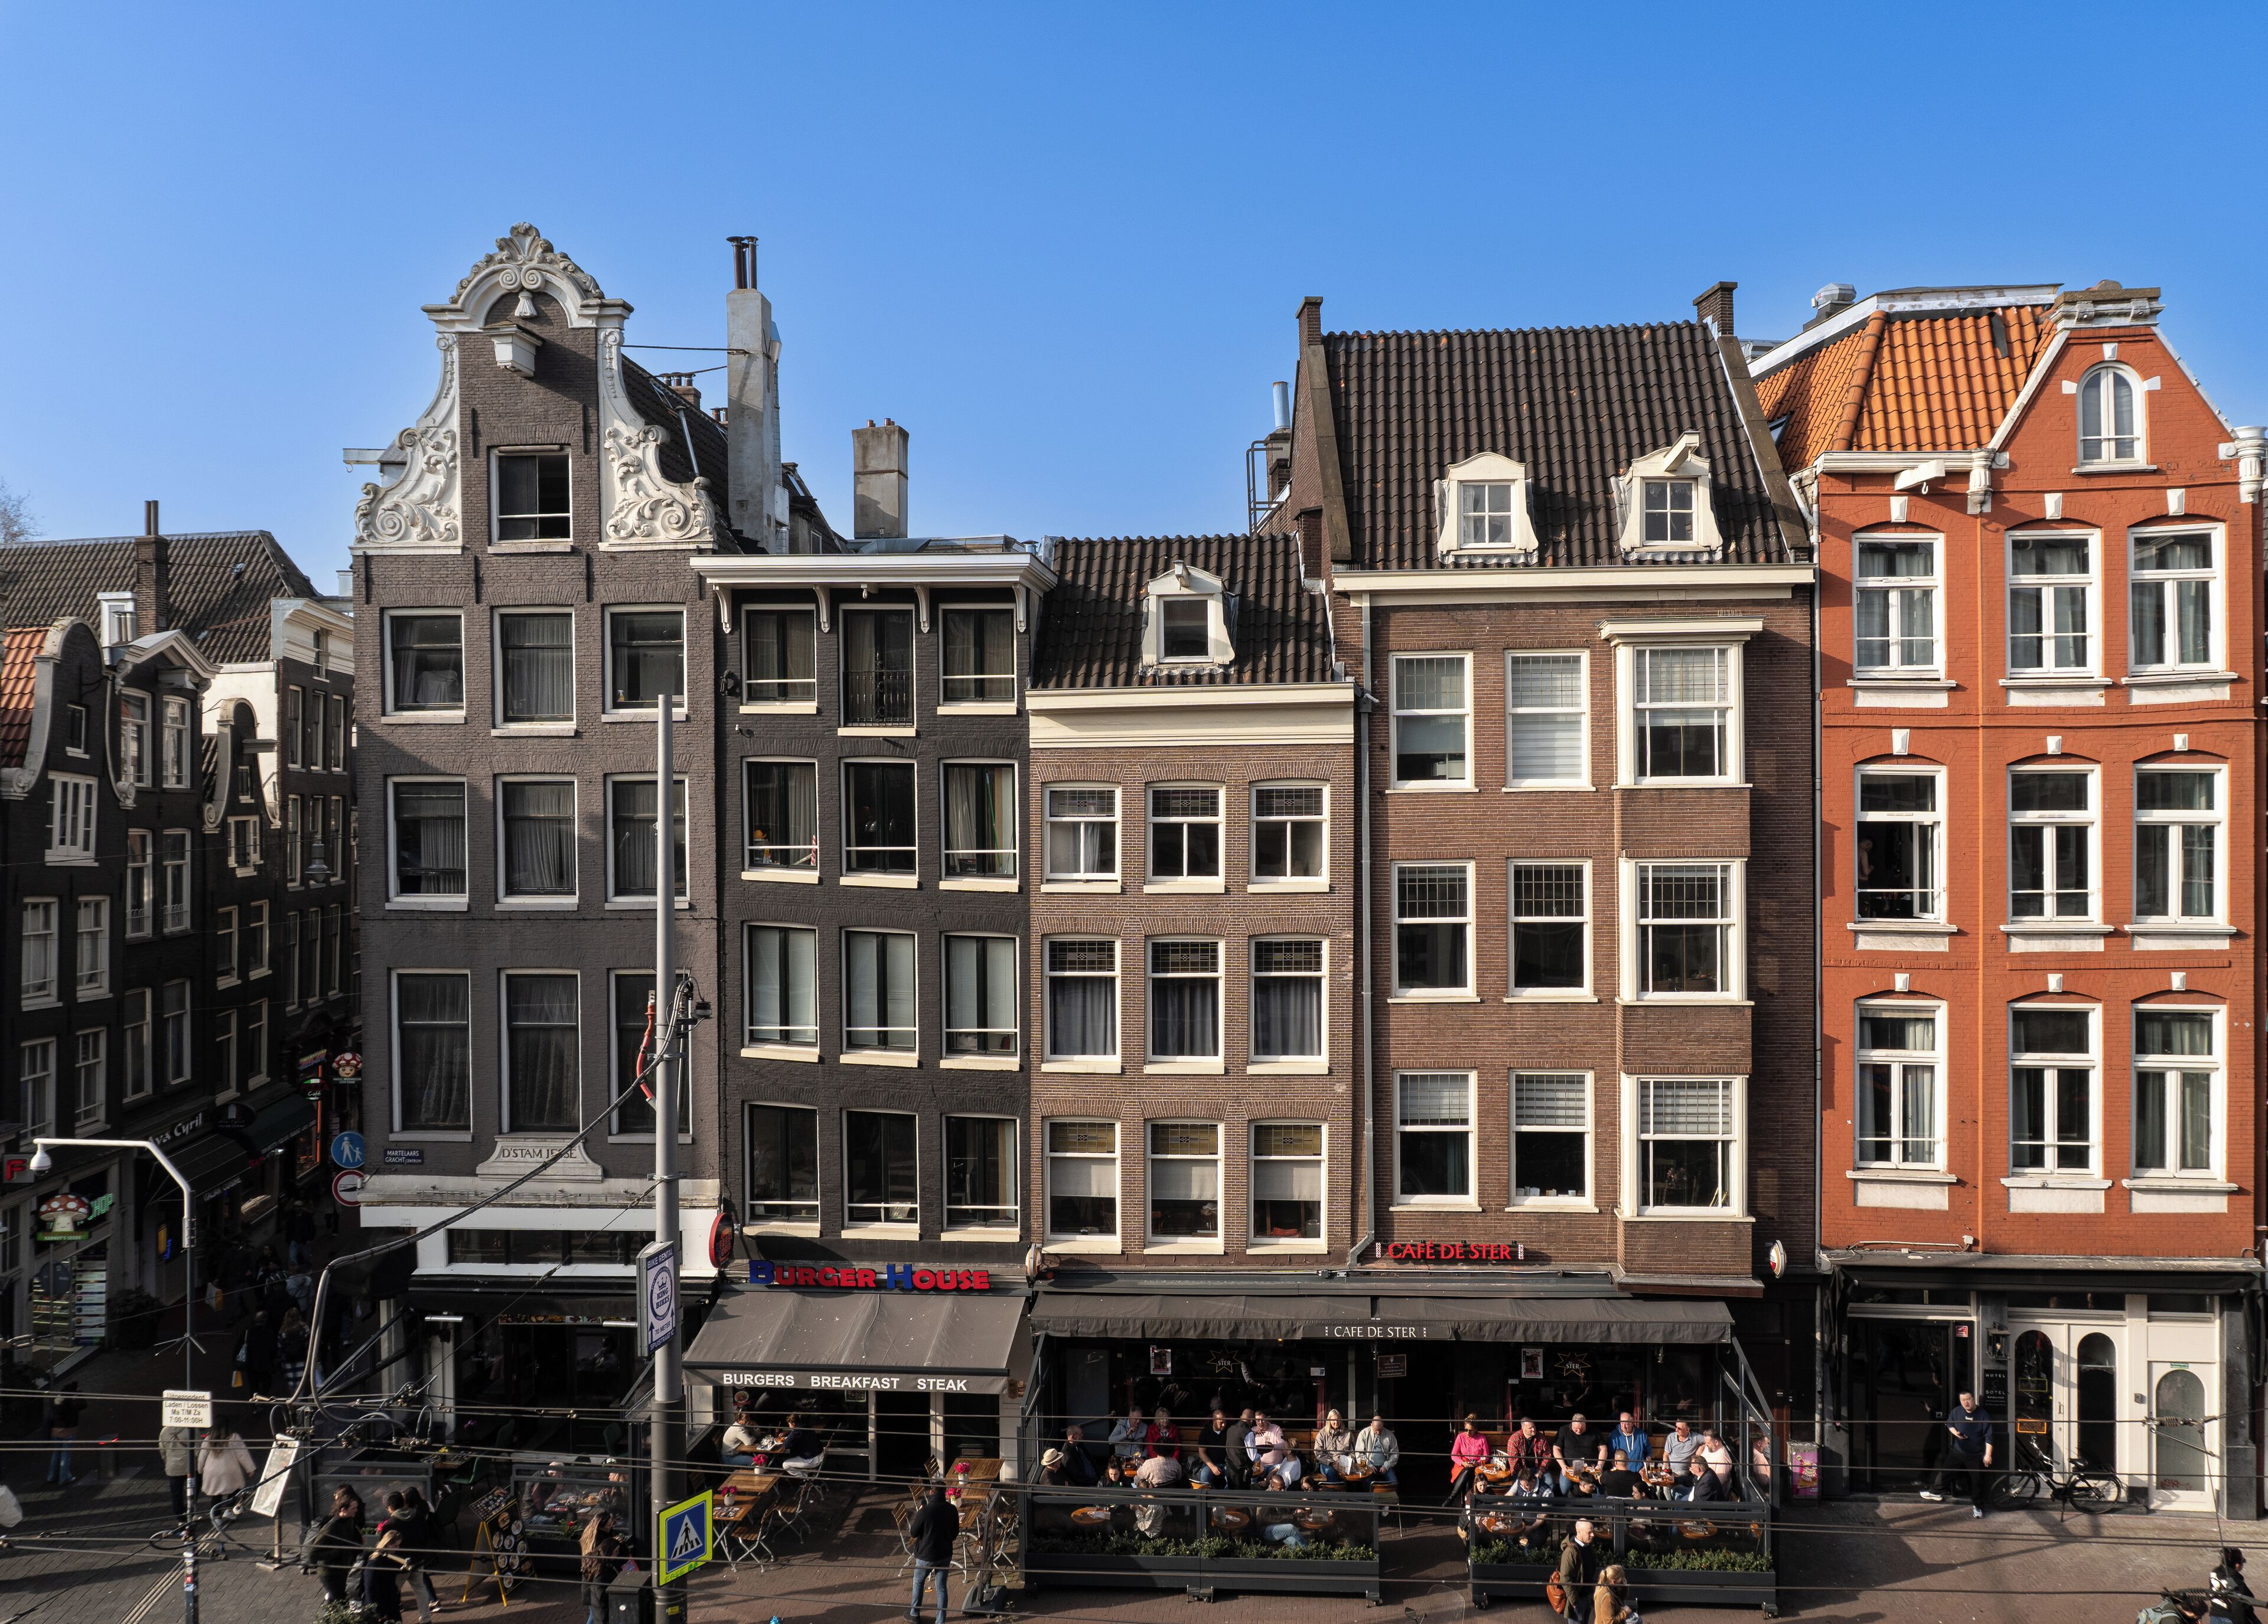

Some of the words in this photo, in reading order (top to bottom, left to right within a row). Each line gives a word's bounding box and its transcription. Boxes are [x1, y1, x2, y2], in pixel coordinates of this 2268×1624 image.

[174, 1112, 203, 1136] Cyril
[6, 1159, 28, 1181] F
[647, 1257, 658, 1269] BIKE
[659, 1248, 673, 1263] RENTAL
[1388, 1239, 1435, 1259] CAFÉ
[1441, 1244, 1465, 1259] DE
[1469, 1244, 1511, 1260] STER
[749, 1260, 876, 1287] BURGER
[886, 1263, 990, 1290] HOUSE
[656, 1287, 669, 1300] KING
[656, 1296, 670, 1310] BIKES
[660, 1320, 671, 1333] METER
[1334, 1326, 1364, 1338] CAFE
[1368, 1326, 1384, 1338] DE
[1387, 1327, 1417, 1338] STER
[723, 1373, 795, 1387] BURGERS
[810, 1375, 900, 1390] BREAKFAST
[917, 1378, 967, 1391] STEAK
